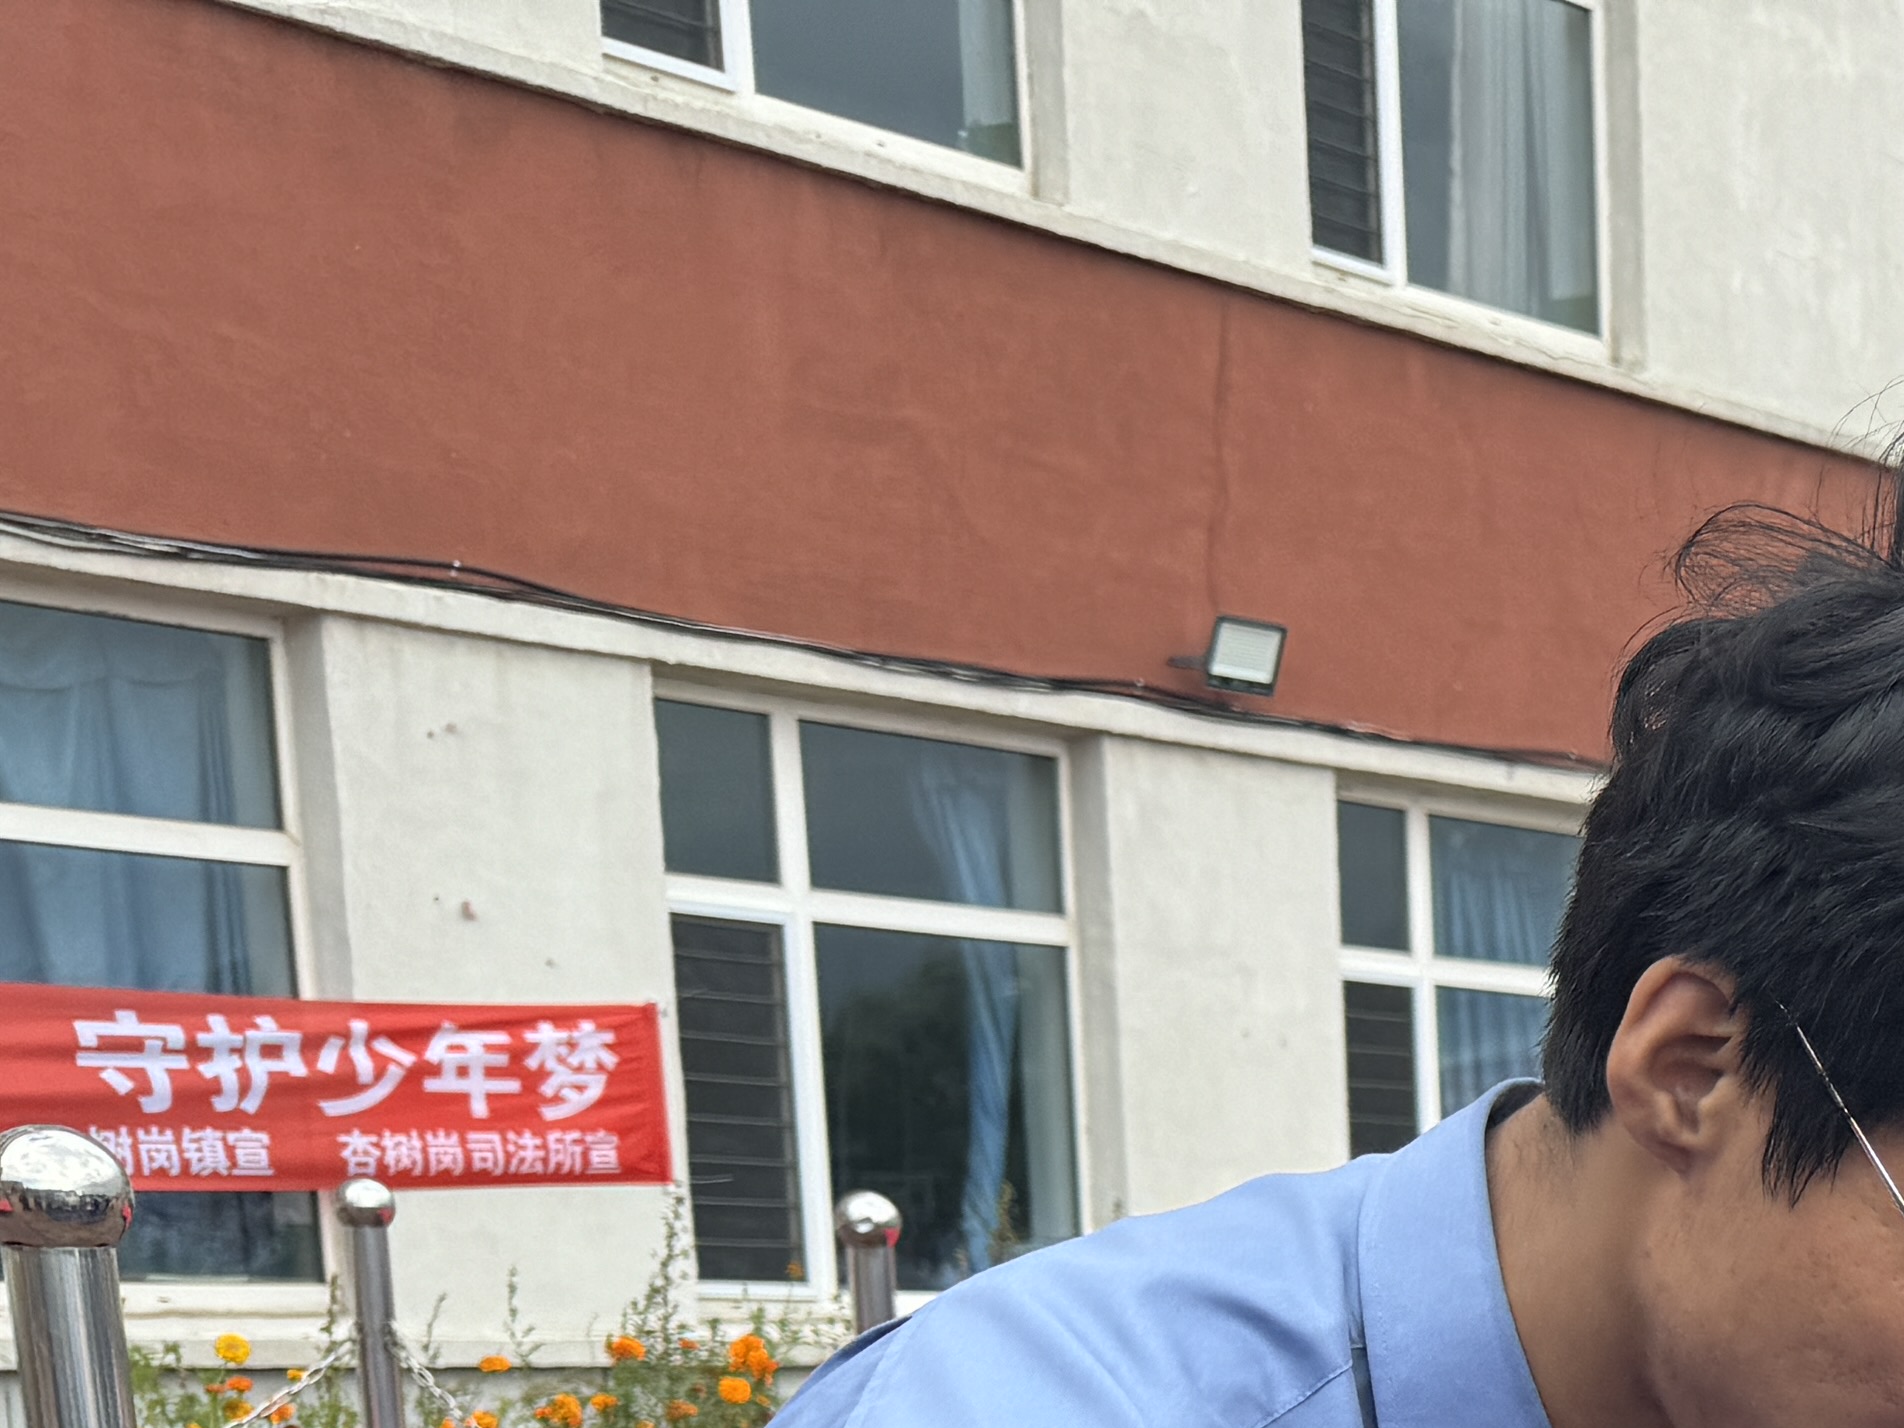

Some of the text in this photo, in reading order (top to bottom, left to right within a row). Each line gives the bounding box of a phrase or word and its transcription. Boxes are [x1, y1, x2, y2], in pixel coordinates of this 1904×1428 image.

[74, 1009, 620, 1121] 守护少年梦
[337, 1128, 621, 1177] 杏树岗司法所宣
